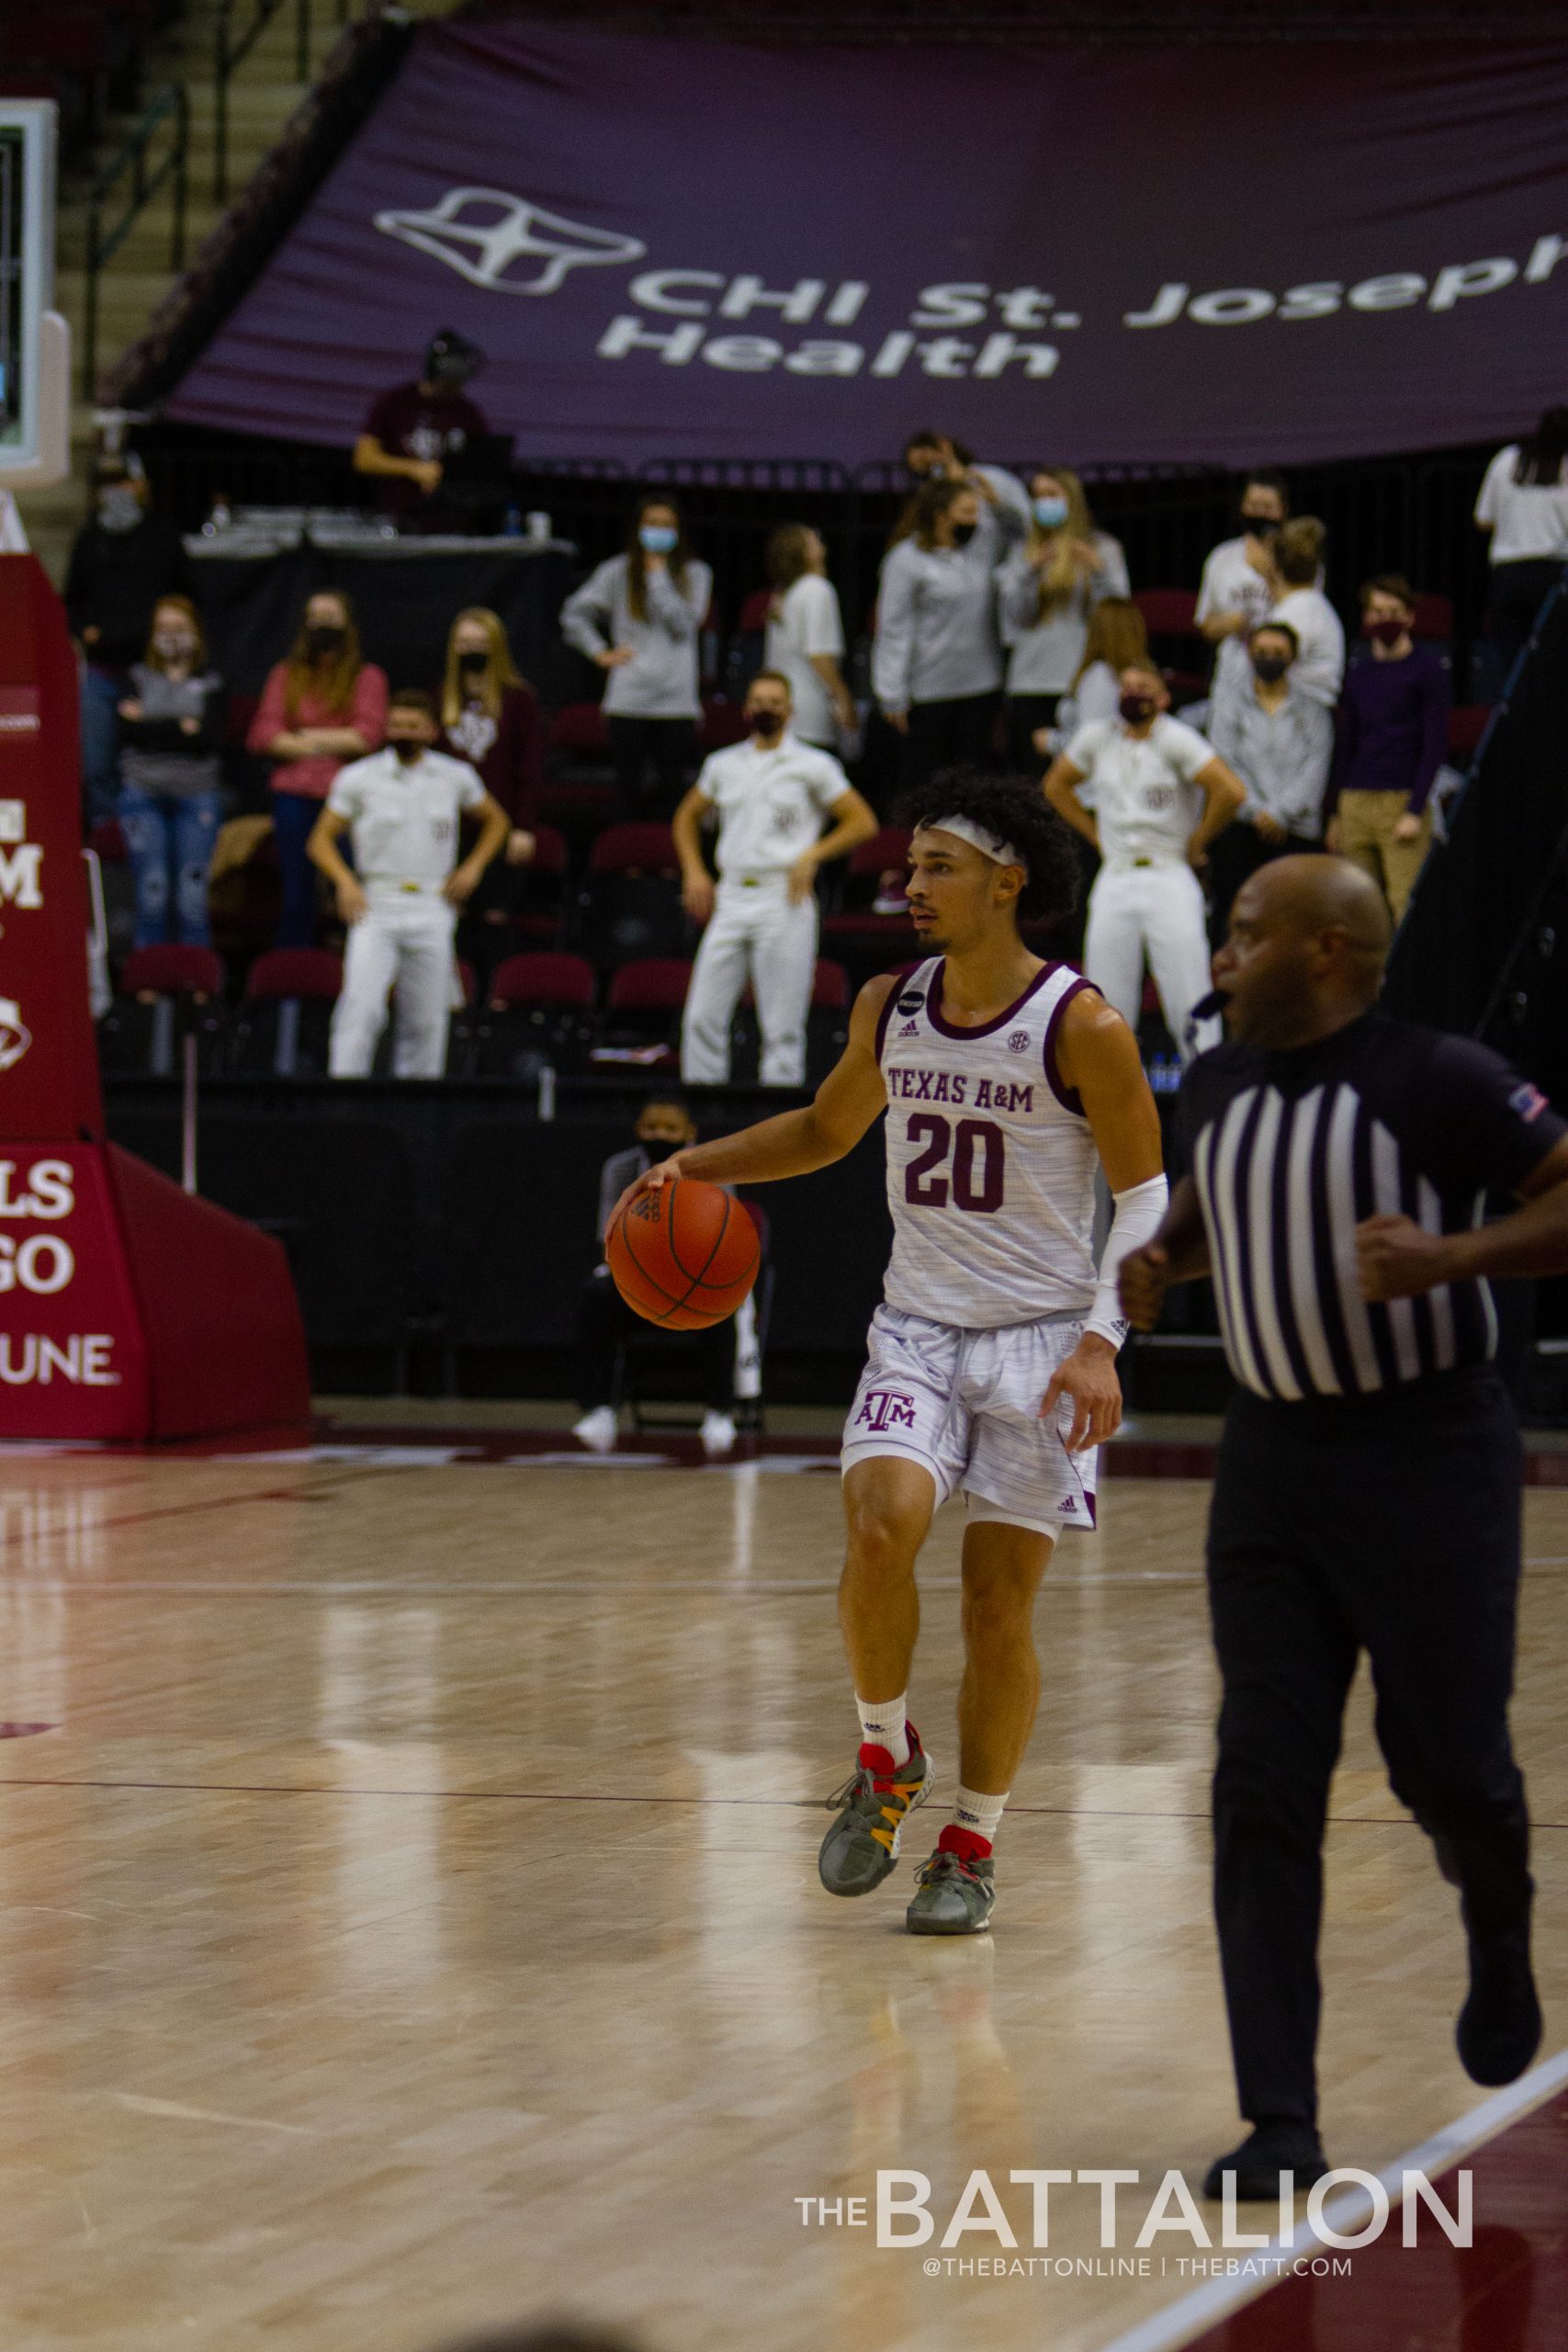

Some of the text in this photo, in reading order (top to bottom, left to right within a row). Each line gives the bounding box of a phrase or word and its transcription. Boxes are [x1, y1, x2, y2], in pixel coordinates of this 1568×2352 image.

[628, 270, 868, 324] CHI
[911, 282, 1081, 328] St.
[597, 315, 1060, 379] Health
[1011, 1033, 1028, 1050] SEC
[888, 1068, 1034, 1112] TEXAS A&M
[905, 1113, 1004, 1213] 20
